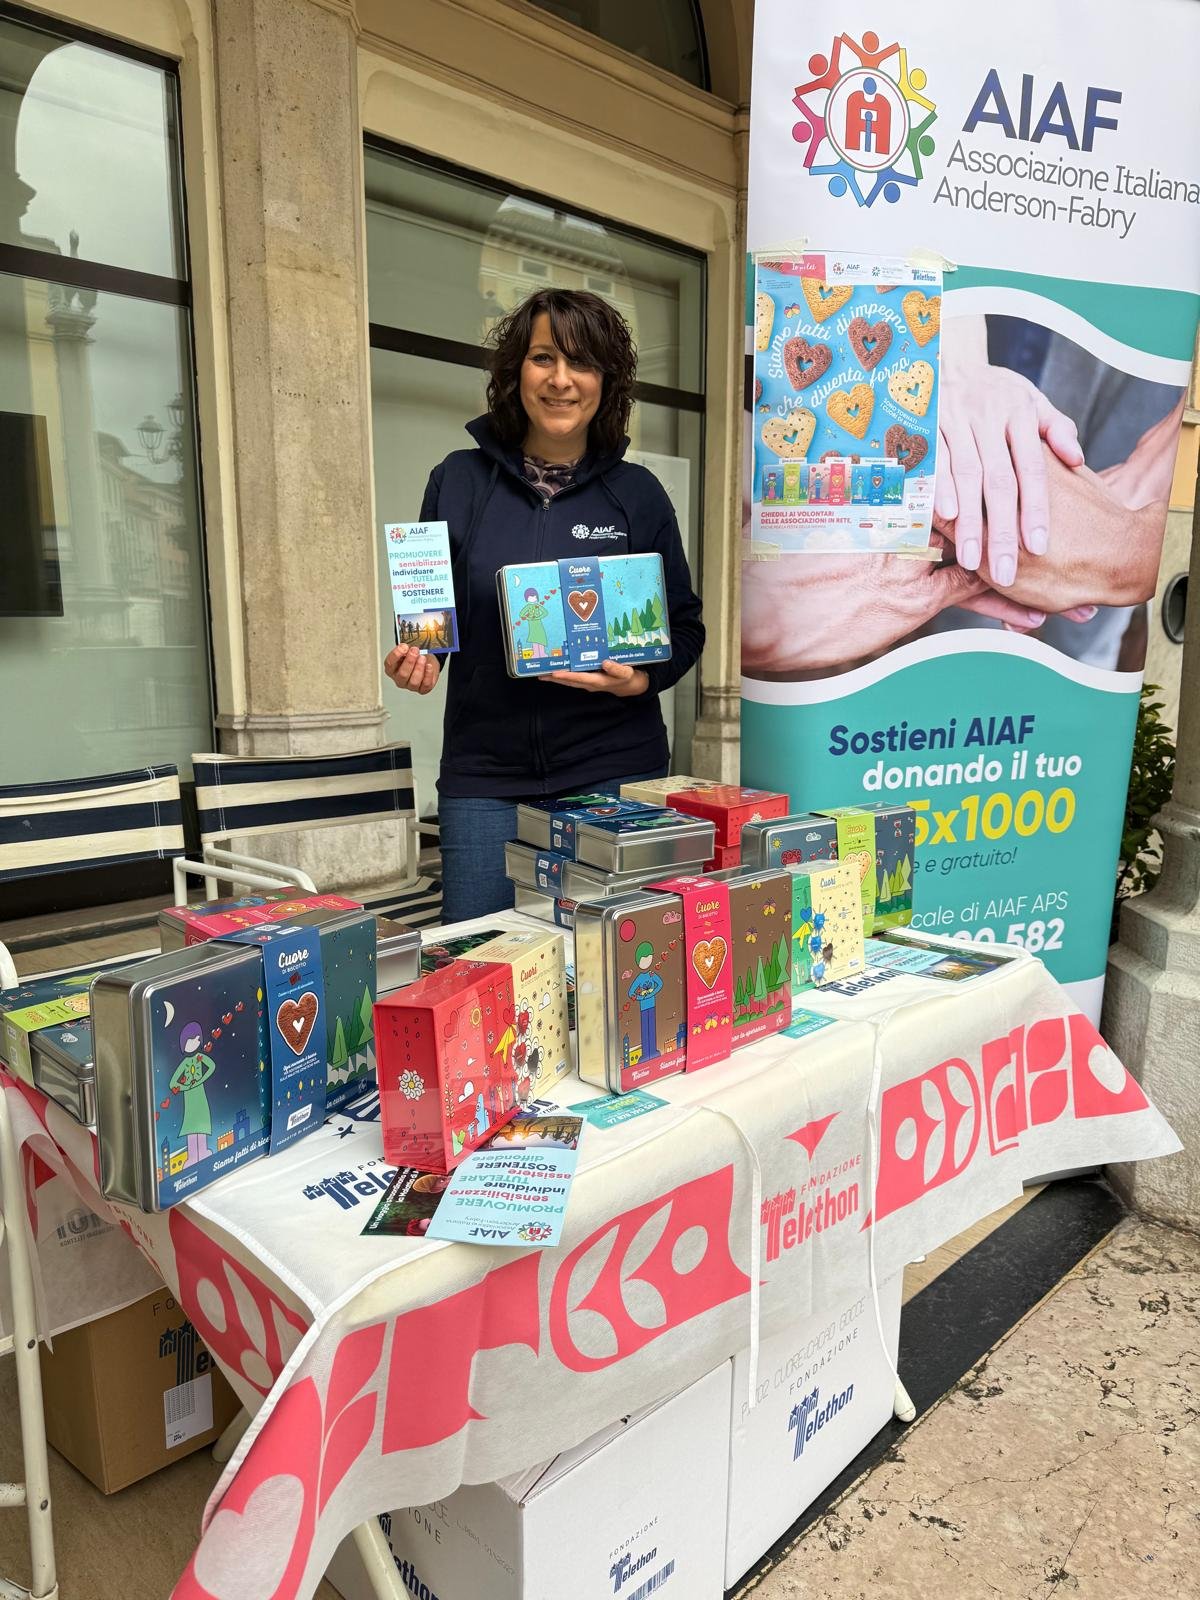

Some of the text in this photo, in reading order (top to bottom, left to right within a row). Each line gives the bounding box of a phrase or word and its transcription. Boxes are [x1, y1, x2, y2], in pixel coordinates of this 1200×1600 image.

[961, 68, 1123, 152] AIAF
[946, 139, 1200, 206] Associazione Italiana
[933, 175, 1137, 239] Anderson-Fabry
[768, 303, 907, 379] Siamo fatti di impegno
[777, 356, 911, 417] che diventa forza
[409, 526, 429, 535] AIAF
[592, 525, 615, 534] AIAF
[389, 549, 443, 560] PROMUOVERE
[399, 559, 449, 568] sensibilizzare
[392, 568, 434, 576] individuare
[412, 574, 448, 582] TUTELARE
[568, 565, 592, 574] Cuore
[402, 588, 444, 597] SOSTENERE
[410, 596, 449, 605] diffondere
[828, 714, 1036, 756] Sostieni AIAF
[862, 750, 1083, 791] donando il tuo
[907, 787, 1077, 847] 5x1000
[924, 857, 937, 874] e
[939, 846, 1018, 875] gratuito!
[696, 900, 720, 914] Cuore
[908, 891, 1069, 929] cale di AIAF APS
[1006, 917, 1065, 953] 582
[278, 949, 310, 968] Cuore
[520, 963, 537, 982] Cuori
[212, 1136, 270, 1172] Siamo fatti di rice
[472, 1154, 544, 1162] diffondere
[357, 1156, 386, 1171] FON
[475, 1161, 557, 1172] SOSTENERE
[459, 1174, 530, 1184] TUTELARE
[507, 1168, 572, 1180] assistere
[800, 1154, 862, 1195] FNDAZIONE
[174, 1175, 198, 1193] Telethon
[484, 1181, 566, 1195] individuare
[450, 1189, 549, 1202] sensibilizzare
[456, 1197, 564, 1213] PROMUOVERE
[760, 1182, 859, 1263] Telethon
[468, 1227, 512, 1239] AIAF
[152, 1299, 176, 1317] FO
[789, 1327, 858, 1395] FONDAZIONE
[788, 1383, 854, 1462] Telethon
[609, 1515, 659, 1560] FONDAZIONE
[609, 1547, 657, 1594] Telethon
